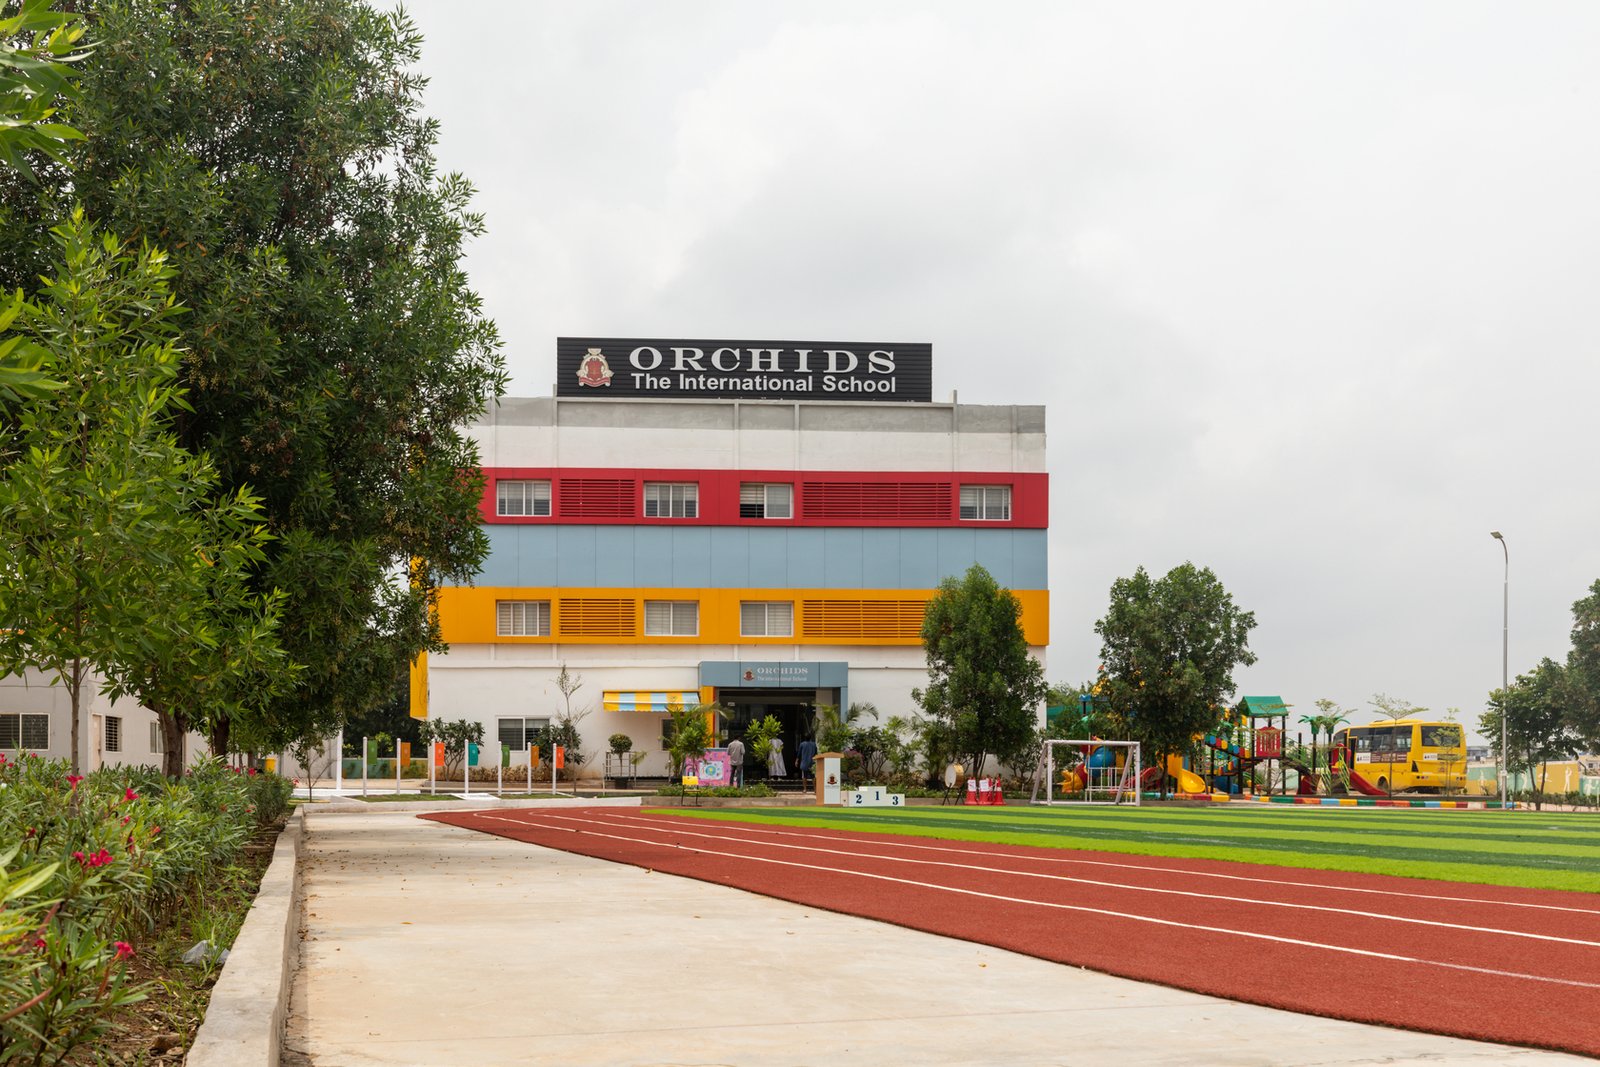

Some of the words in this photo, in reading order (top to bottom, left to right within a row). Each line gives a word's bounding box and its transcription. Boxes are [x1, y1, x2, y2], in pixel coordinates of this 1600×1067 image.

[629, 346, 896, 374] ORCHIDS
[630, 372, 672, 390] The
[679, 373, 813, 392] International
[822, 374, 896, 393] School
[856, 794, 862, 804] 2
[875, 791, 879, 800] 1
[892, 796, 899, 805] 3
